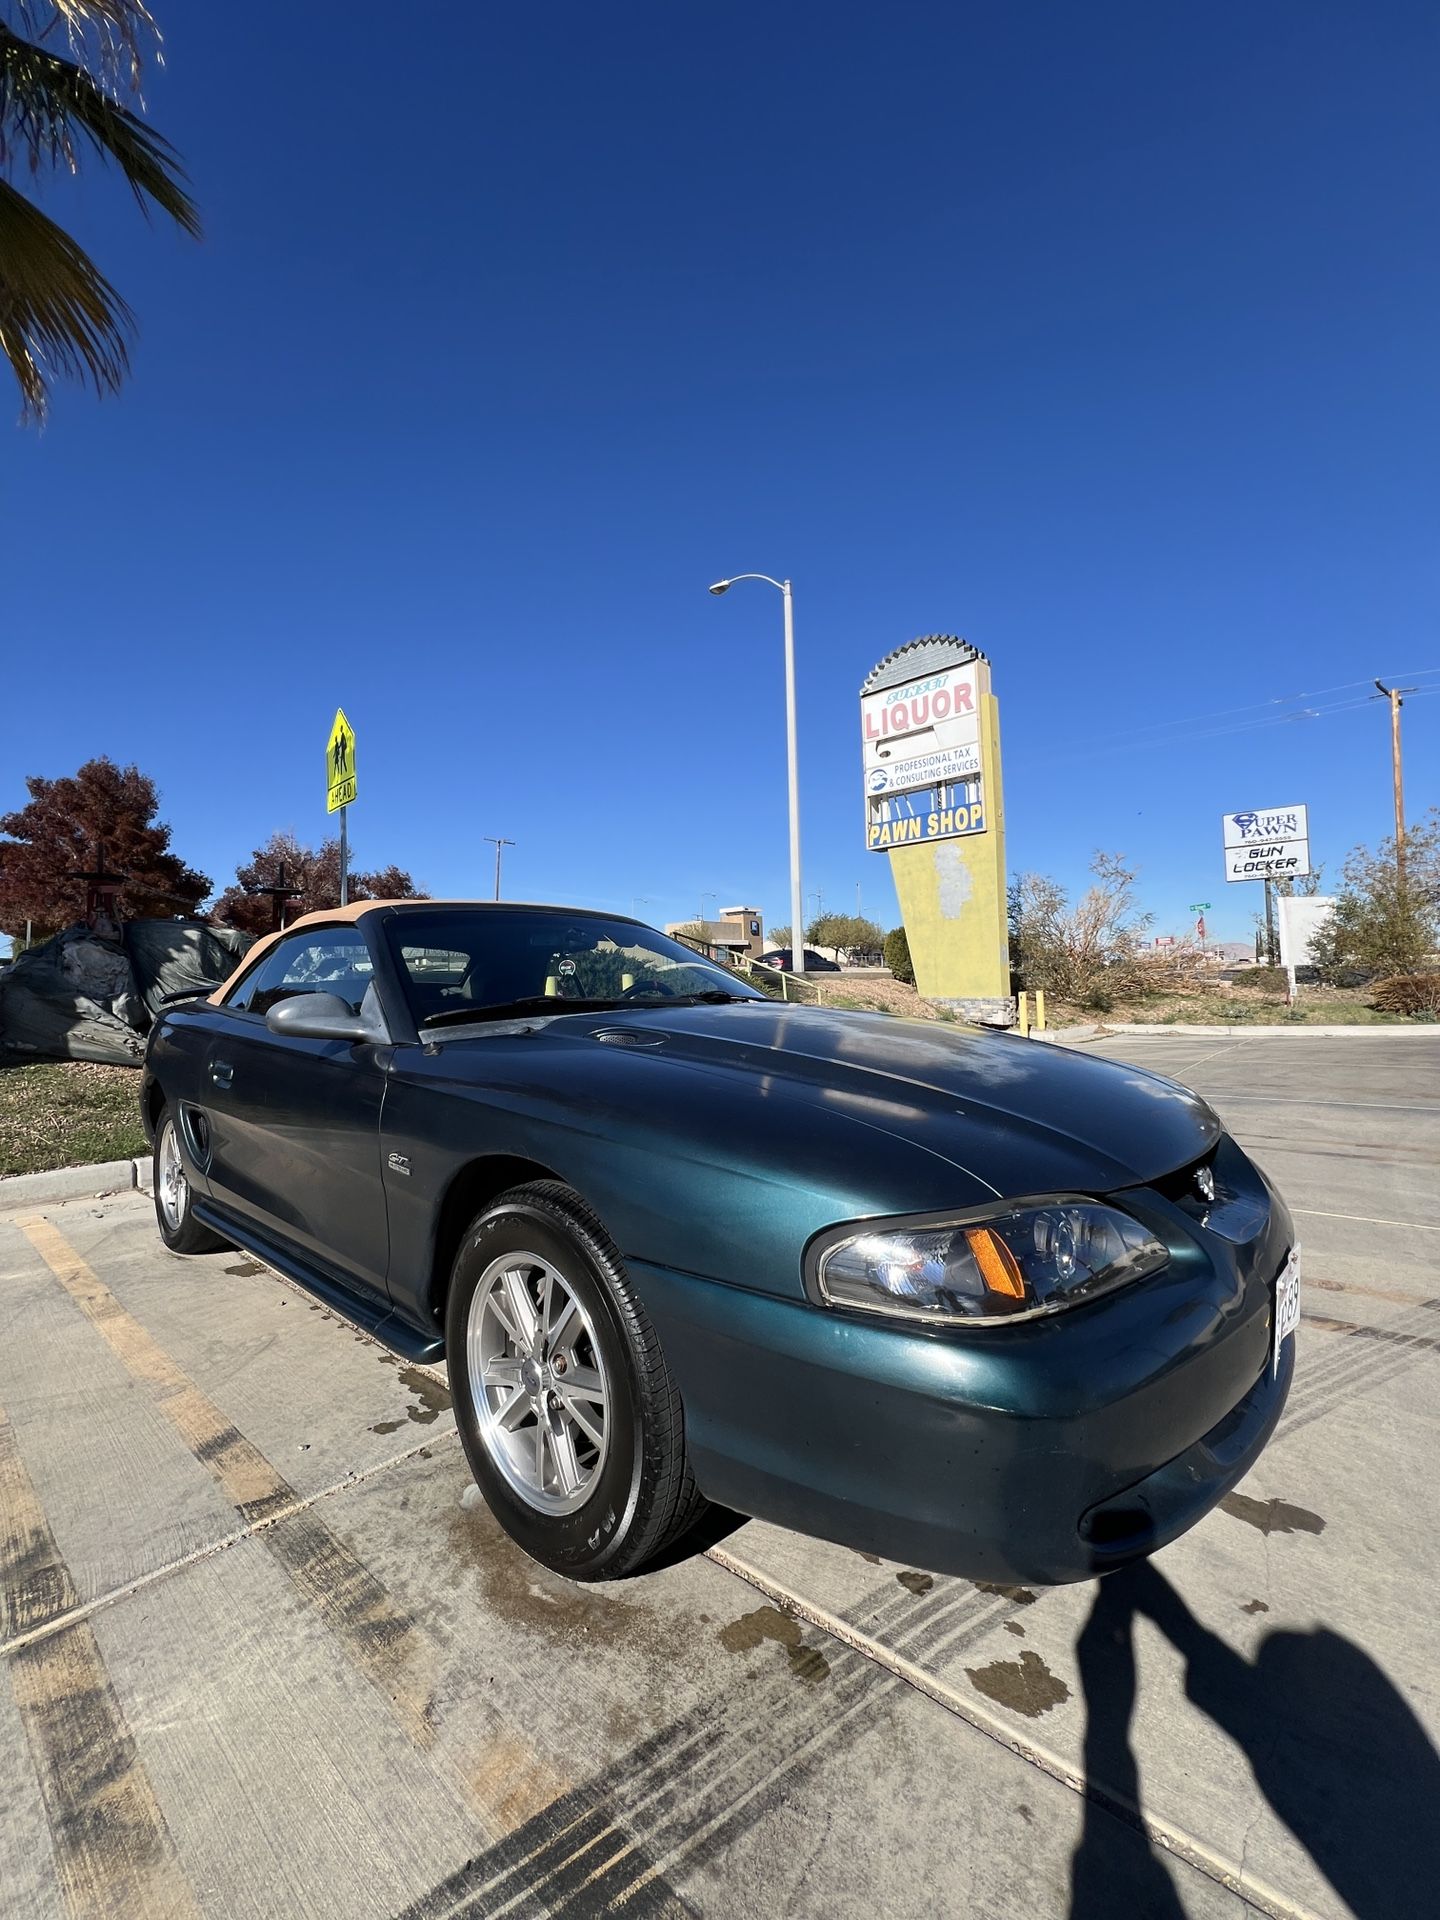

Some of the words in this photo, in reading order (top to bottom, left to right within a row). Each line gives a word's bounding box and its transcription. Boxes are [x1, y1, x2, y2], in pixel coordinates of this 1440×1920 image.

[886, 675, 949, 705] SUNSET
[865, 682, 974, 740] LIQUOR
[889, 778, 895, 787] &
[896, 766, 942, 786] CONSULTING
[943, 758, 979, 776] SERVICES
[894, 752, 953, 773] PROFESSIONAL
[954, 747, 971, 761] TAX
[869, 817, 922, 847] PAWN
[928, 803, 982, 836] SHOP
[1240, 823, 1298, 838] PAWN
[1249, 845, 1284, 858] GUN
[1233, 857, 1298, 873] LOCKER
[389, 1153, 408, 1164] GT
